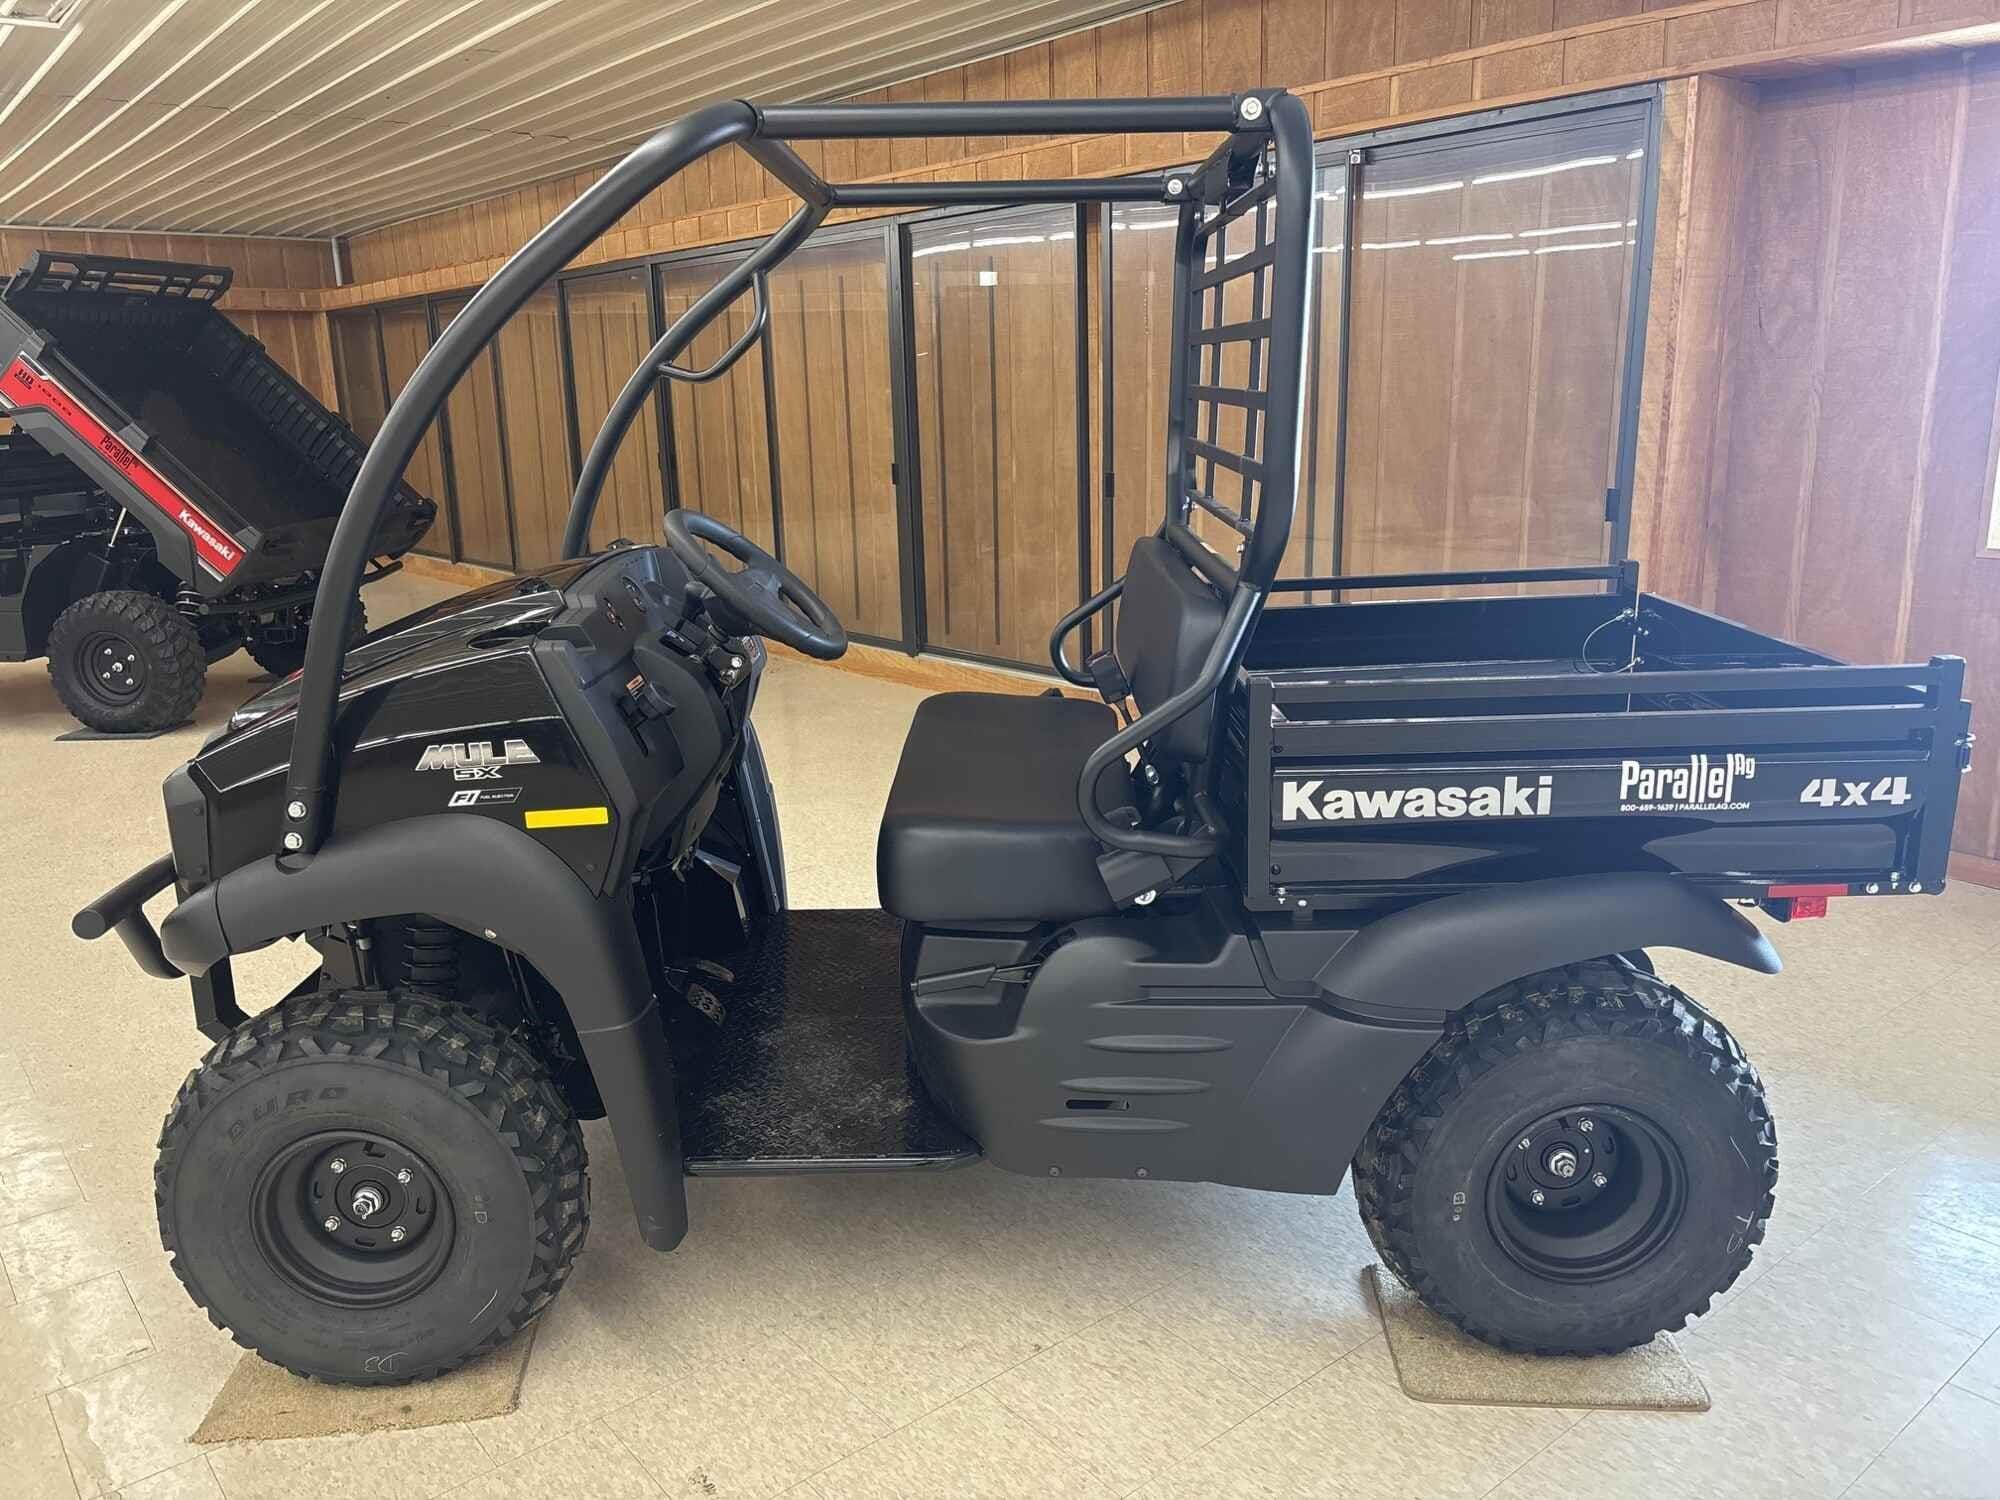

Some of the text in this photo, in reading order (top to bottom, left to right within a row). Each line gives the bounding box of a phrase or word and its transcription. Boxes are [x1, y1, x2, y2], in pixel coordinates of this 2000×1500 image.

[179, 509, 236, 561] Kawasaki
[415, 739, 541, 771] MULE
[453, 766, 503, 780] SX
[1282, 775, 1553, 821] Kawasaki
[1620, 801, 1750, 812] 800-659-1639 PARALLELAG.COM
[1800, 776, 1912, 807] 4x4
